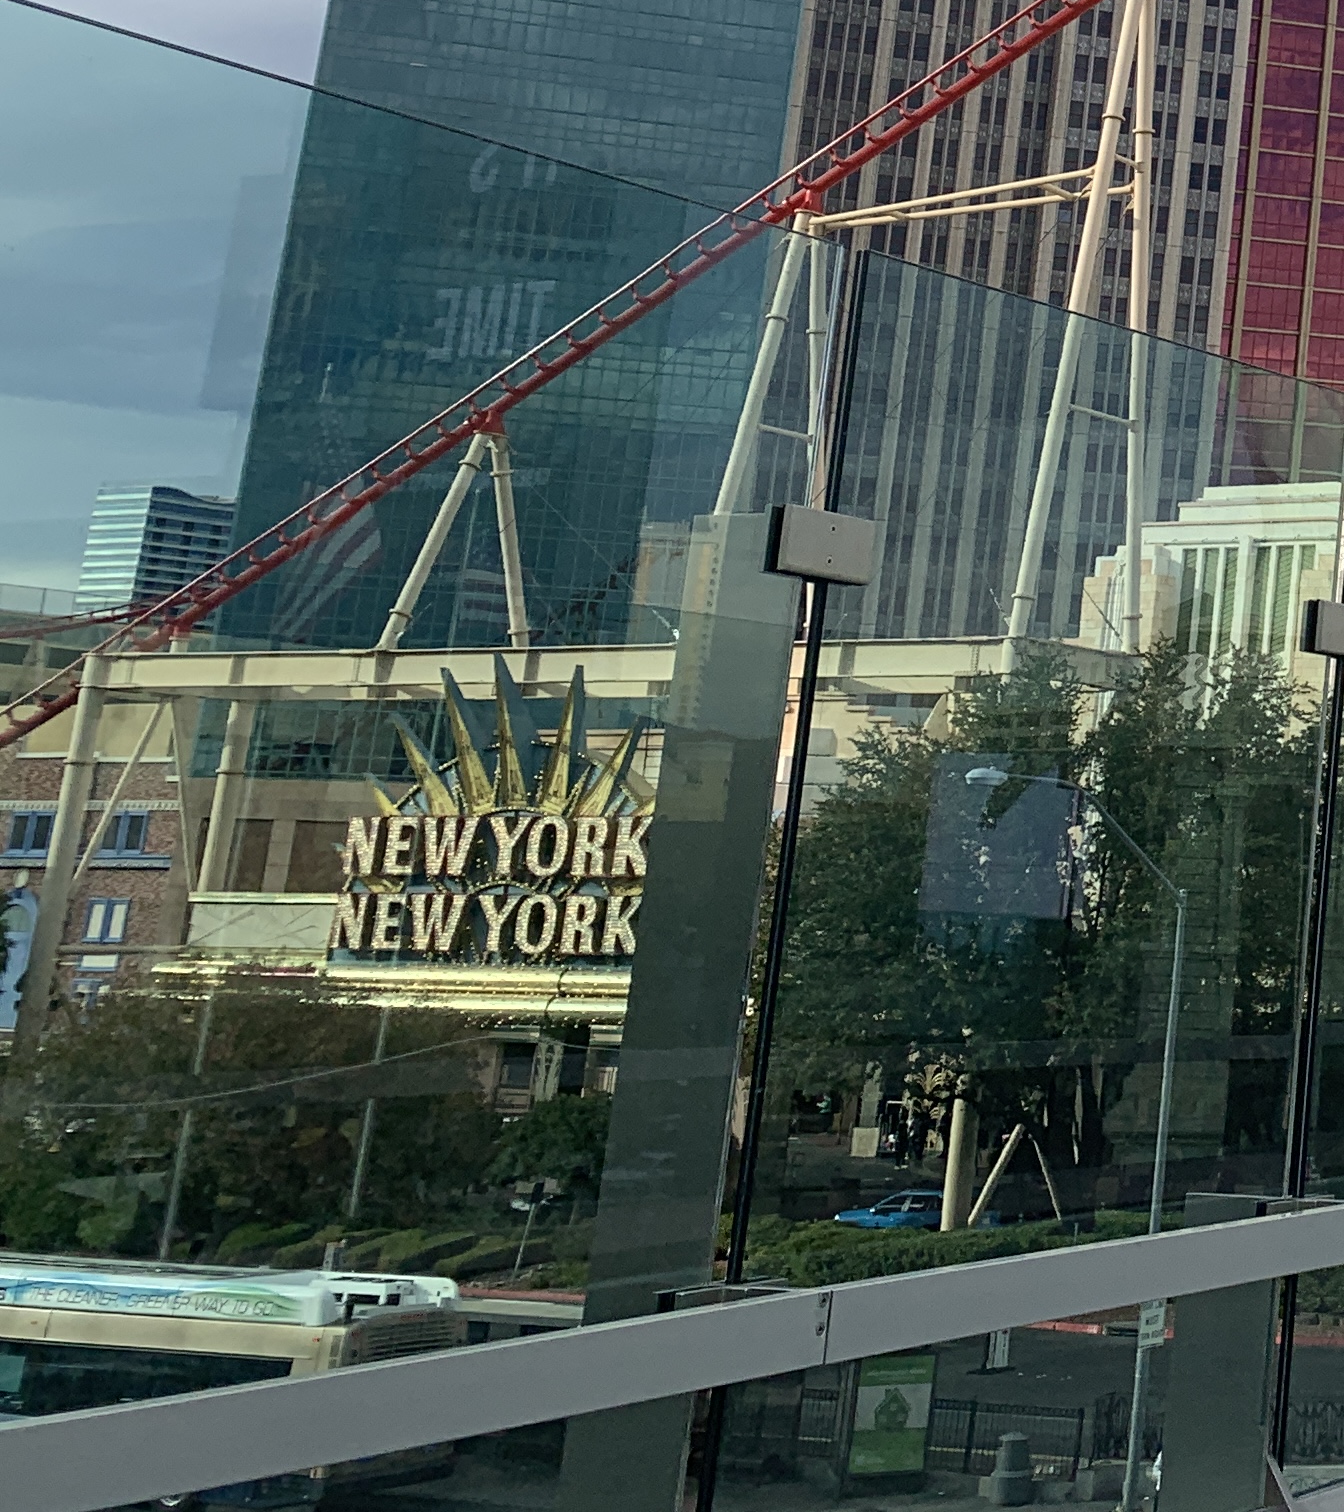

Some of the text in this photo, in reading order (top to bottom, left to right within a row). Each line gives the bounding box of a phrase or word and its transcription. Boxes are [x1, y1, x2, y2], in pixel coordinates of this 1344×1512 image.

[342, 815, 654, 878] NEW YORK
[331, 892, 643, 955] NEW YORK
[30, 1286, 56, 1302] THE
[126, 1293, 190, 1311] GREENER
[194, 1296, 229, 1313] WAY
[232, 1298, 250, 1314] TO
